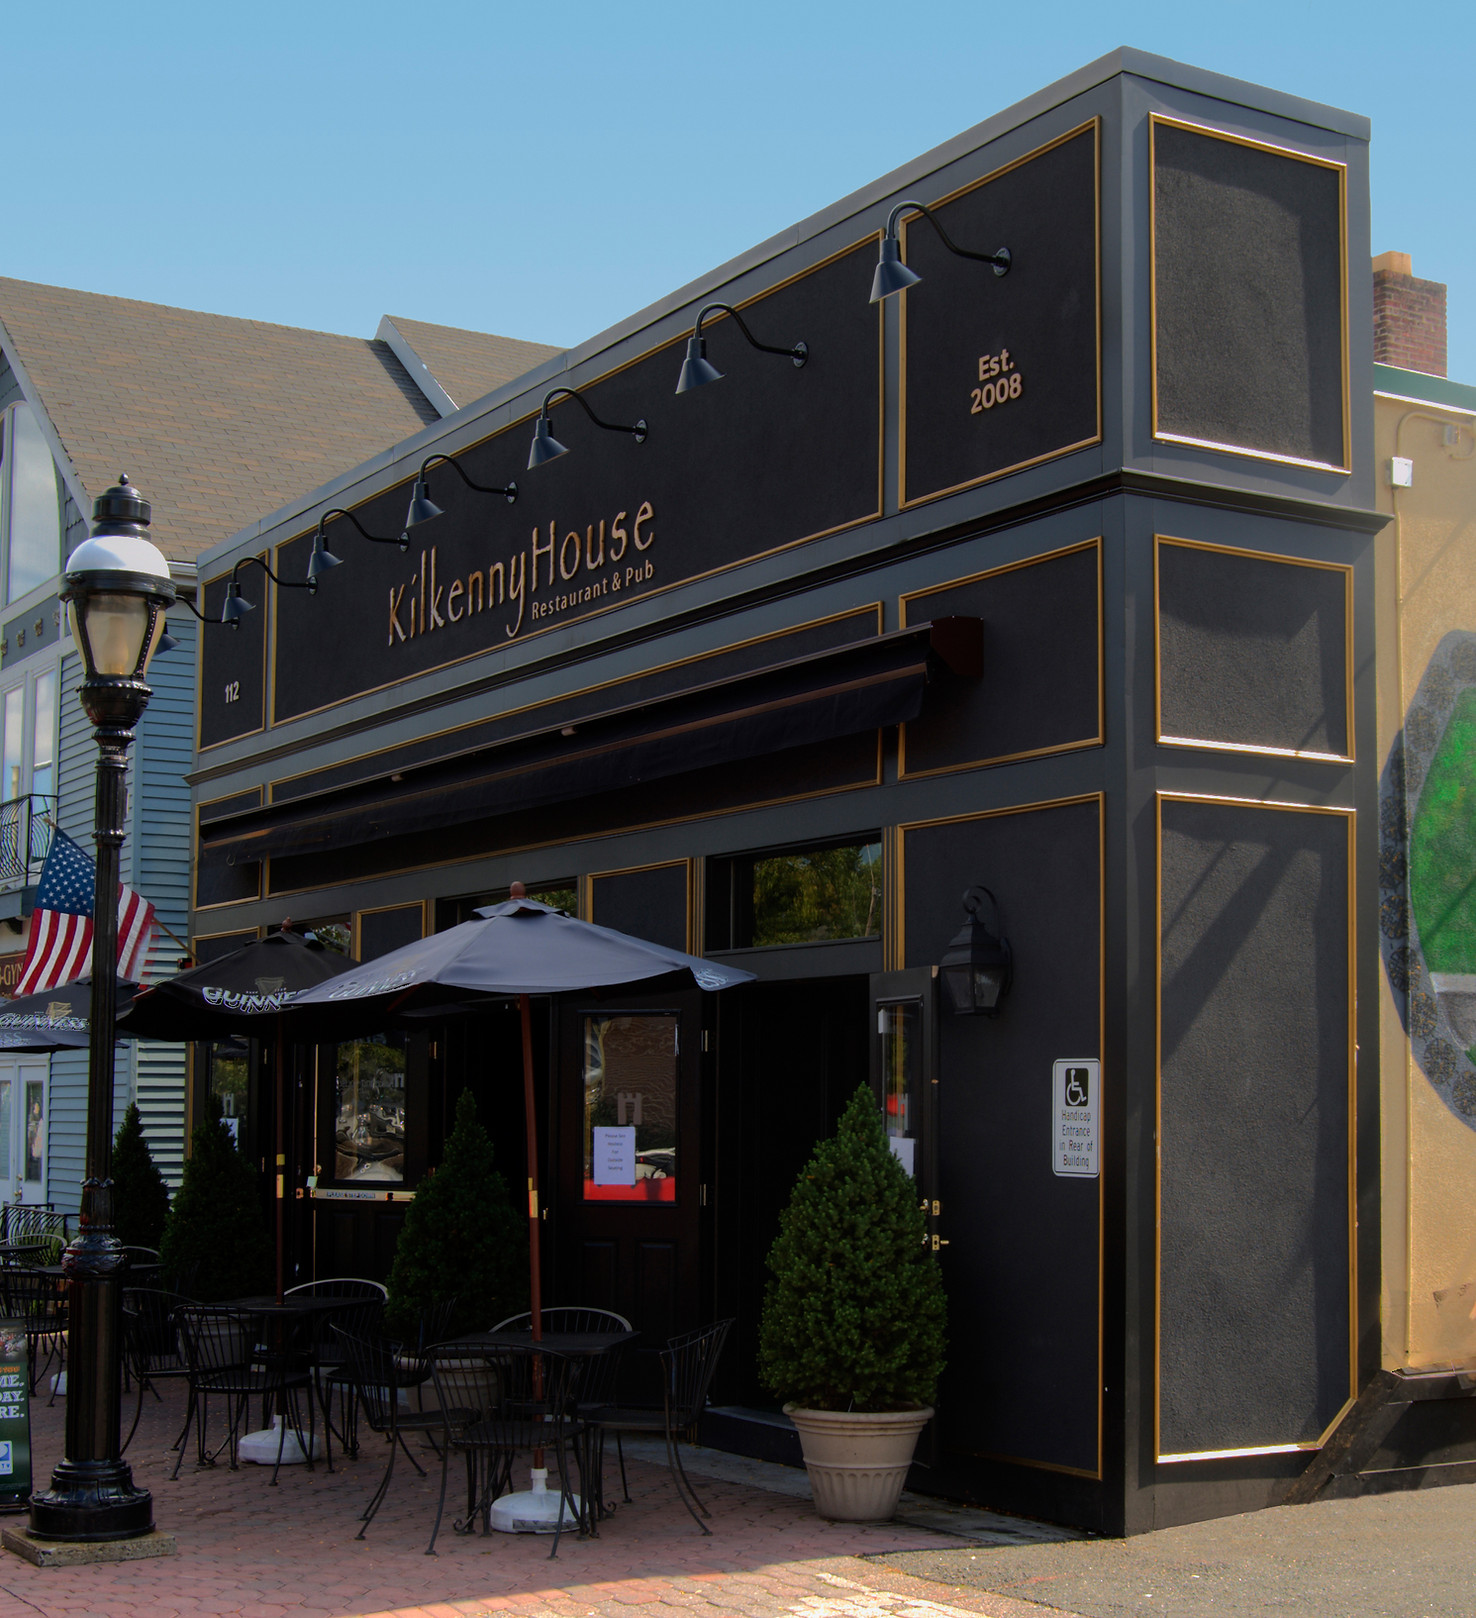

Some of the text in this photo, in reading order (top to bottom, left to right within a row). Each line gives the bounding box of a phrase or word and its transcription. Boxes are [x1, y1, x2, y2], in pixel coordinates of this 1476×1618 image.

[978, 348, 1014, 381] Est.
[970, 372, 1022, 415] 2008
[531, 559, 655, 620] Restaurant & Pub
[224, 680, 240, 704] 112
[1061, 1109, 1092, 1123] Handicap
[1062, 1124, 1091, 1137] Entrance
[1068, 1139, 1084, 1151] Rear
[1087, 1140, 1093, 1152] of
[1063, 1154, 1090, 1171] Building
